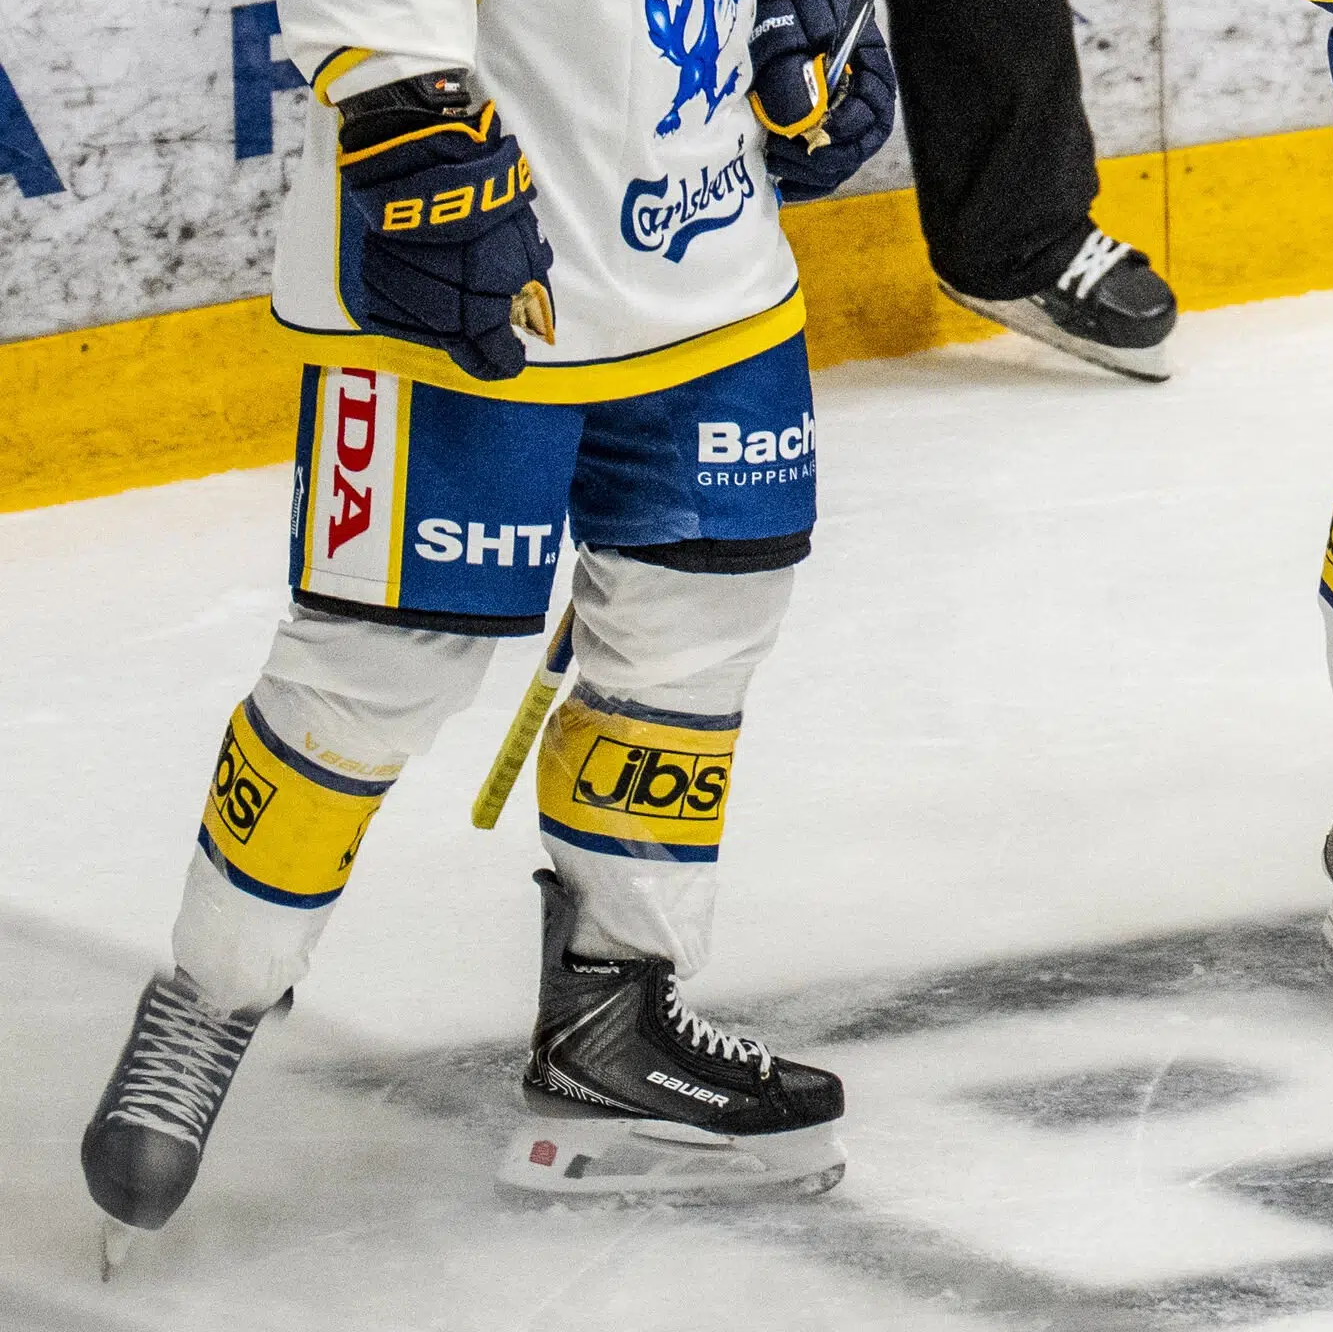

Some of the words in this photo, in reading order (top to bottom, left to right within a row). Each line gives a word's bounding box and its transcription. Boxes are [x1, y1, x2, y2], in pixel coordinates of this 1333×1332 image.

[620, 150, 755, 264] Carlsberg
[328, 368, 377, 559] DA
[697, 414, 814, 464] Bach
[697, 467, 797, 486] GRUPPEN
[415, 518, 552, 566] SHT
[578, 747, 727, 810] jbs
